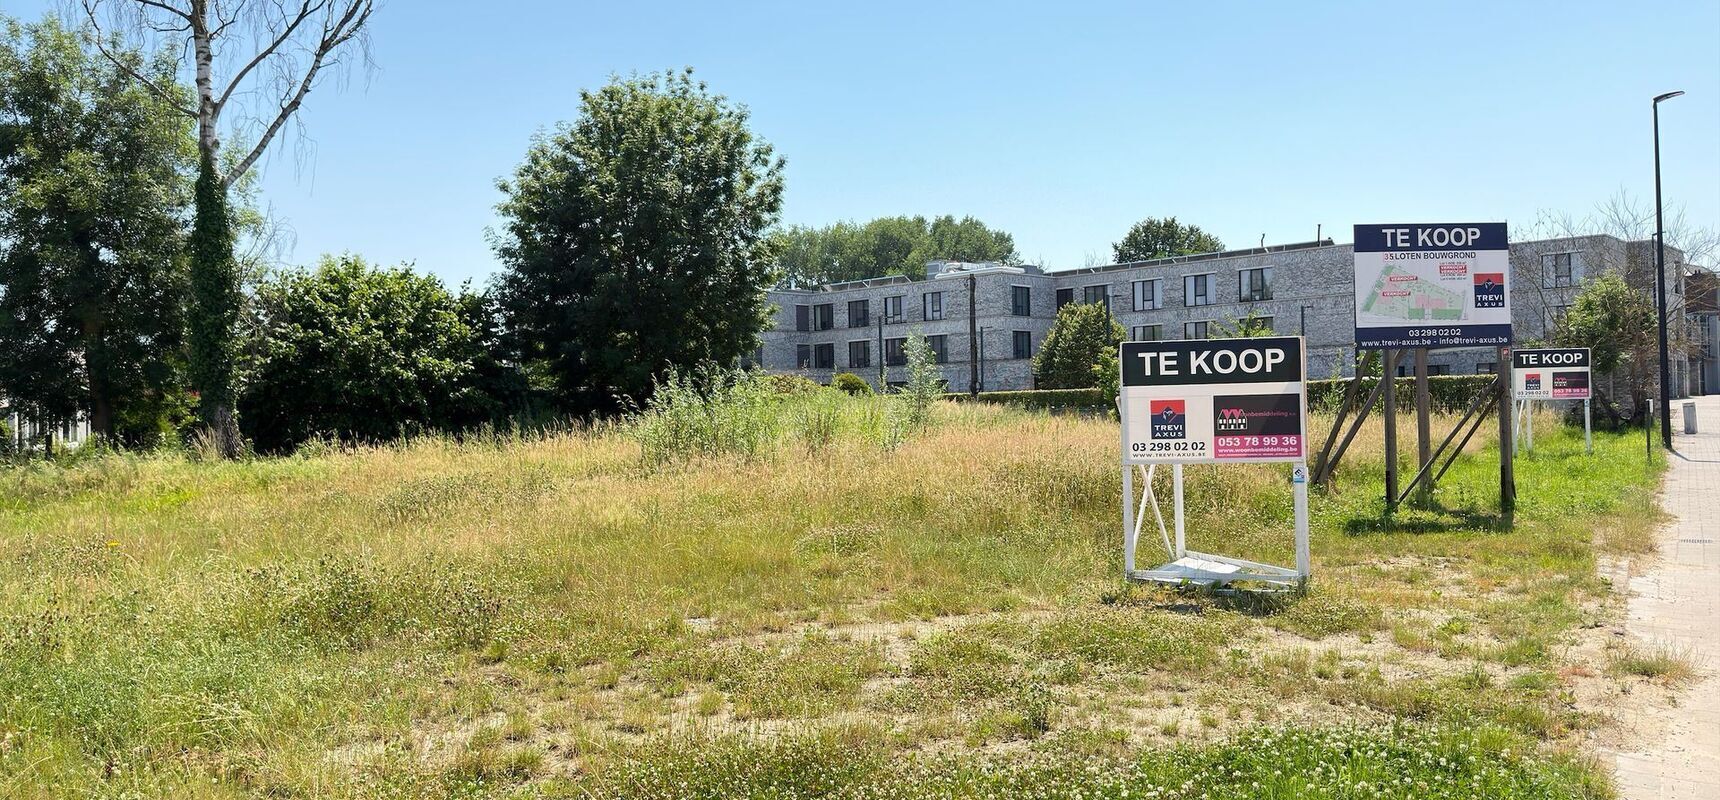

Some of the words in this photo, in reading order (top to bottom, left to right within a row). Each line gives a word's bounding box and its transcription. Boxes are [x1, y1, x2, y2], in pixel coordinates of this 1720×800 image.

[1382, 228, 1410, 248] TE
[1417, 227, 1481, 247] KOOP
[1384, 252, 1394, 261] 35
[1395, 252, 1421, 260] LOTEN
[1423, 251, 1476, 260] BOUWGROND
[1408, 329, 1420, 337] 03
[1420, 329, 1437, 337] 298
[1450, 328, 1462, 336] 02
[1361, 338, 1431, 347] www.trevi-axus.be
[1439, 336, 1508, 346] info@trevi-axus.be
[1137, 351, 1179, 376] TE
[1190, 348, 1285, 375] KOOP
[1519, 353, 1538, 365] TE
[1542, 353, 1583, 364] KOOP
[1132, 442, 1147, 452] 03
[1149, 442, 1171, 452] 298
[1174, 442, 1188, 451] 02
[1191, 441, 1206, 451] 02
[1218, 437, 1241, 447] 053
[1244, 437, 1259, 446] 78
[1262, 436, 1278, 446] 99
[1281, 436, 1297, 446] 36
